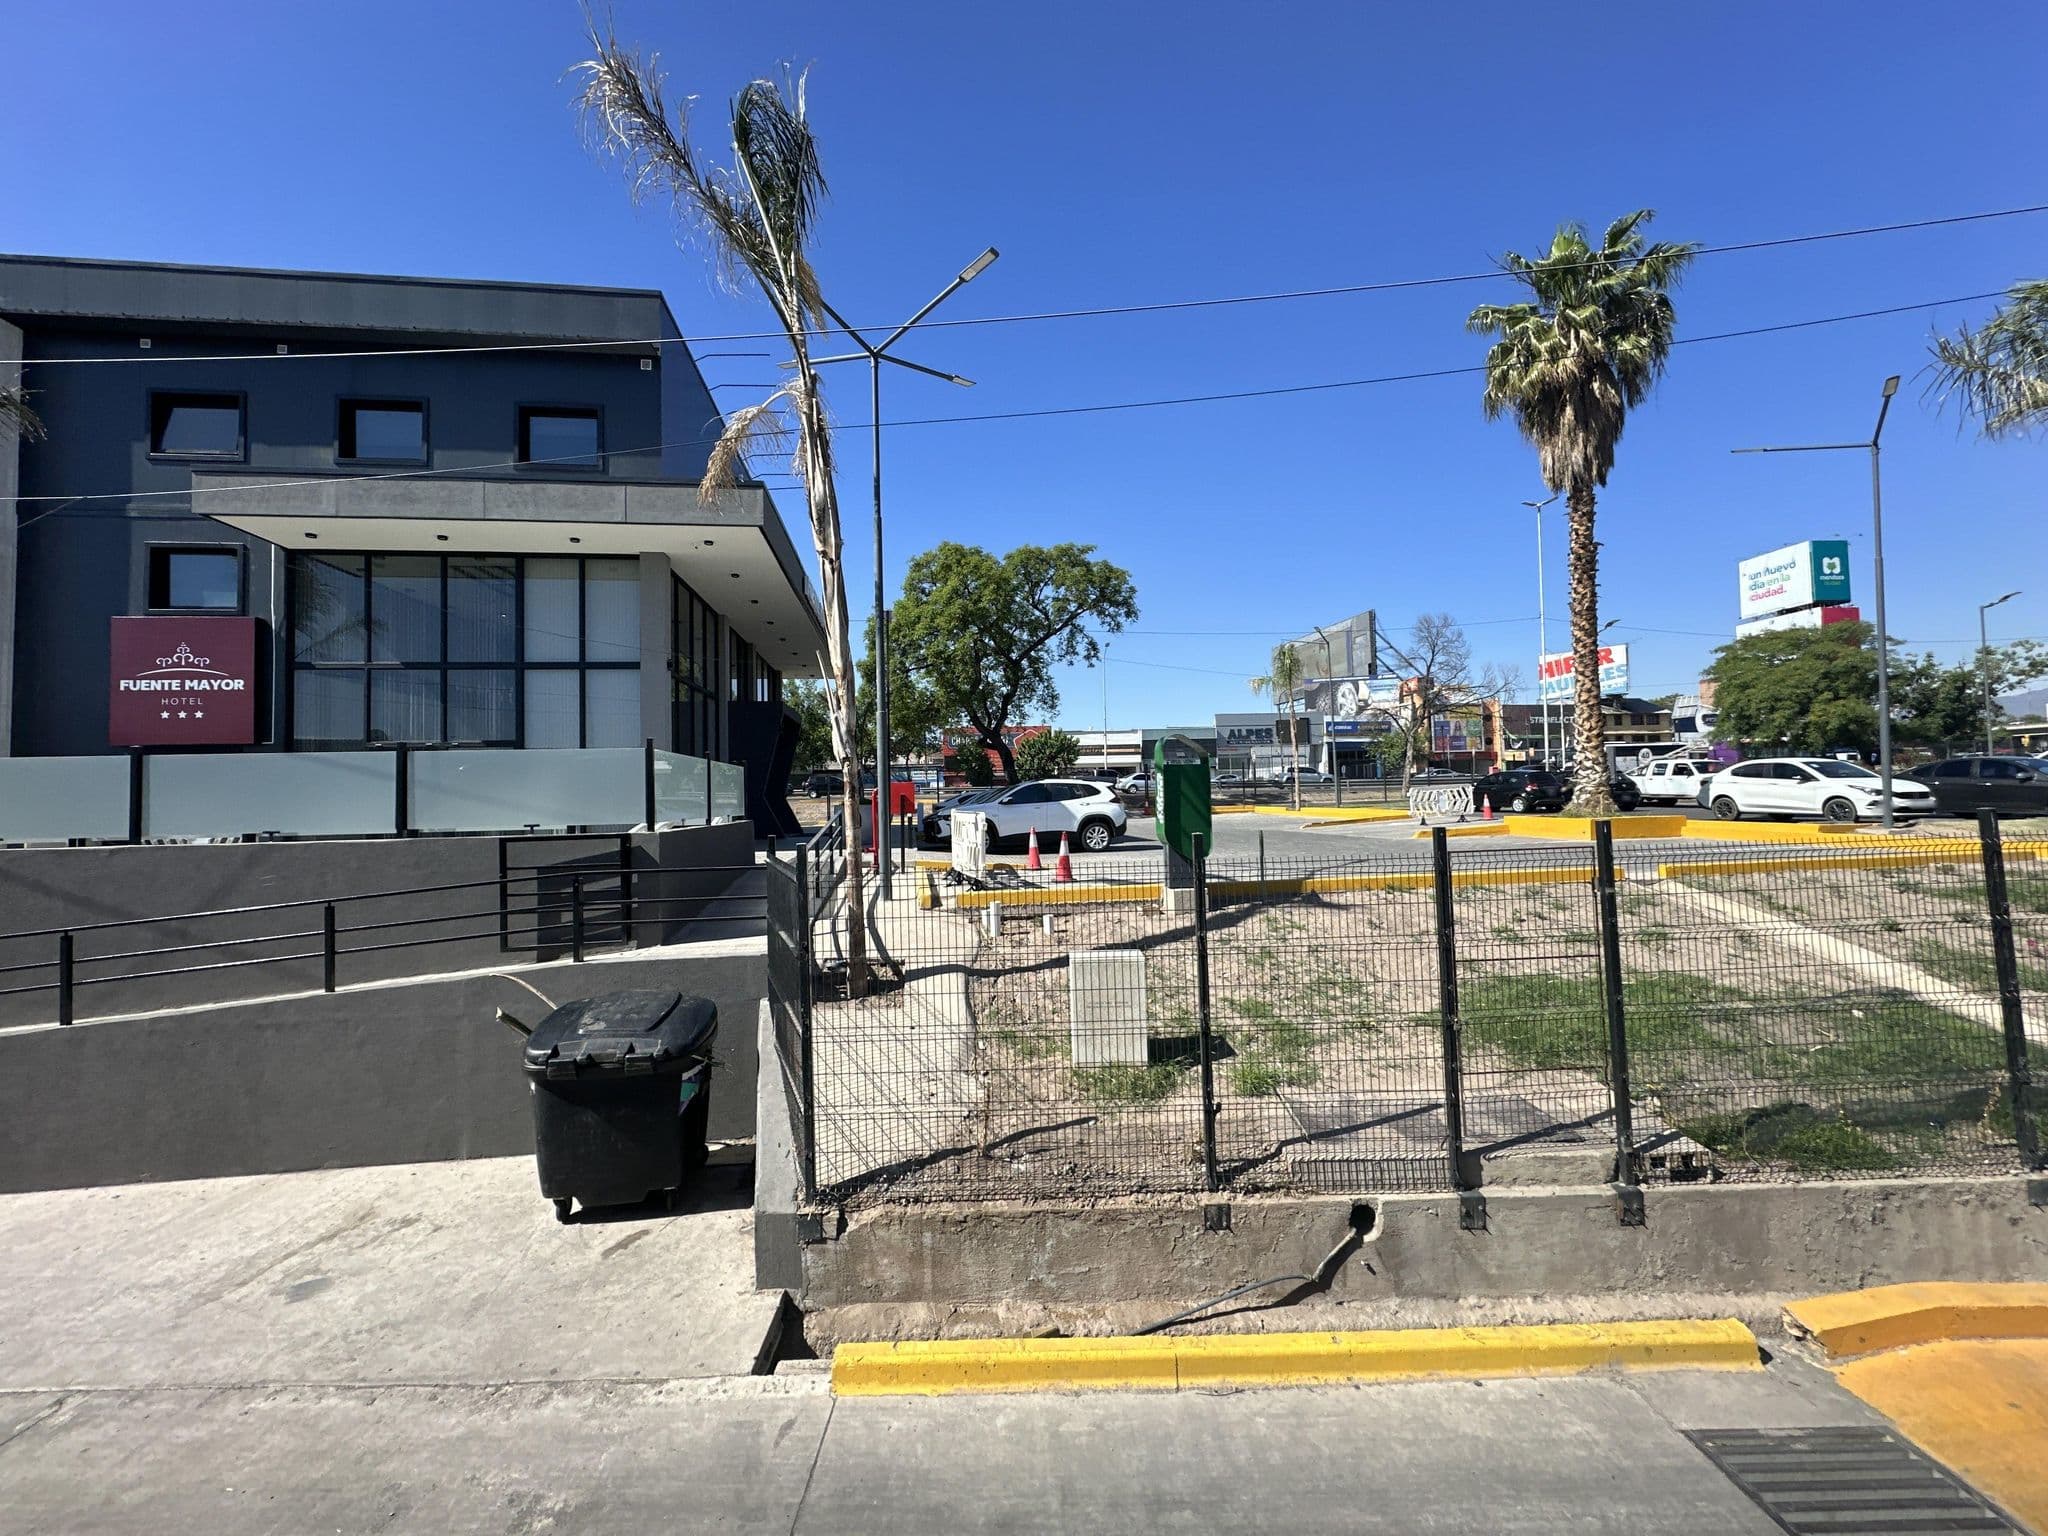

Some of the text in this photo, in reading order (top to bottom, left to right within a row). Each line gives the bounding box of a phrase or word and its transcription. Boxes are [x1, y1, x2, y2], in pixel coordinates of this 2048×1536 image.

[1749, 561, 1797, 581] un nuevo
[1767, 577, 1780, 587] en
[1538, 647, 1615, 680] HIPR
[119, 679, 245, 691] FUENTE MAYOR
[161, 697, 203, 705] HOTEL
[1227, 727, 1274, 740] ALPES
